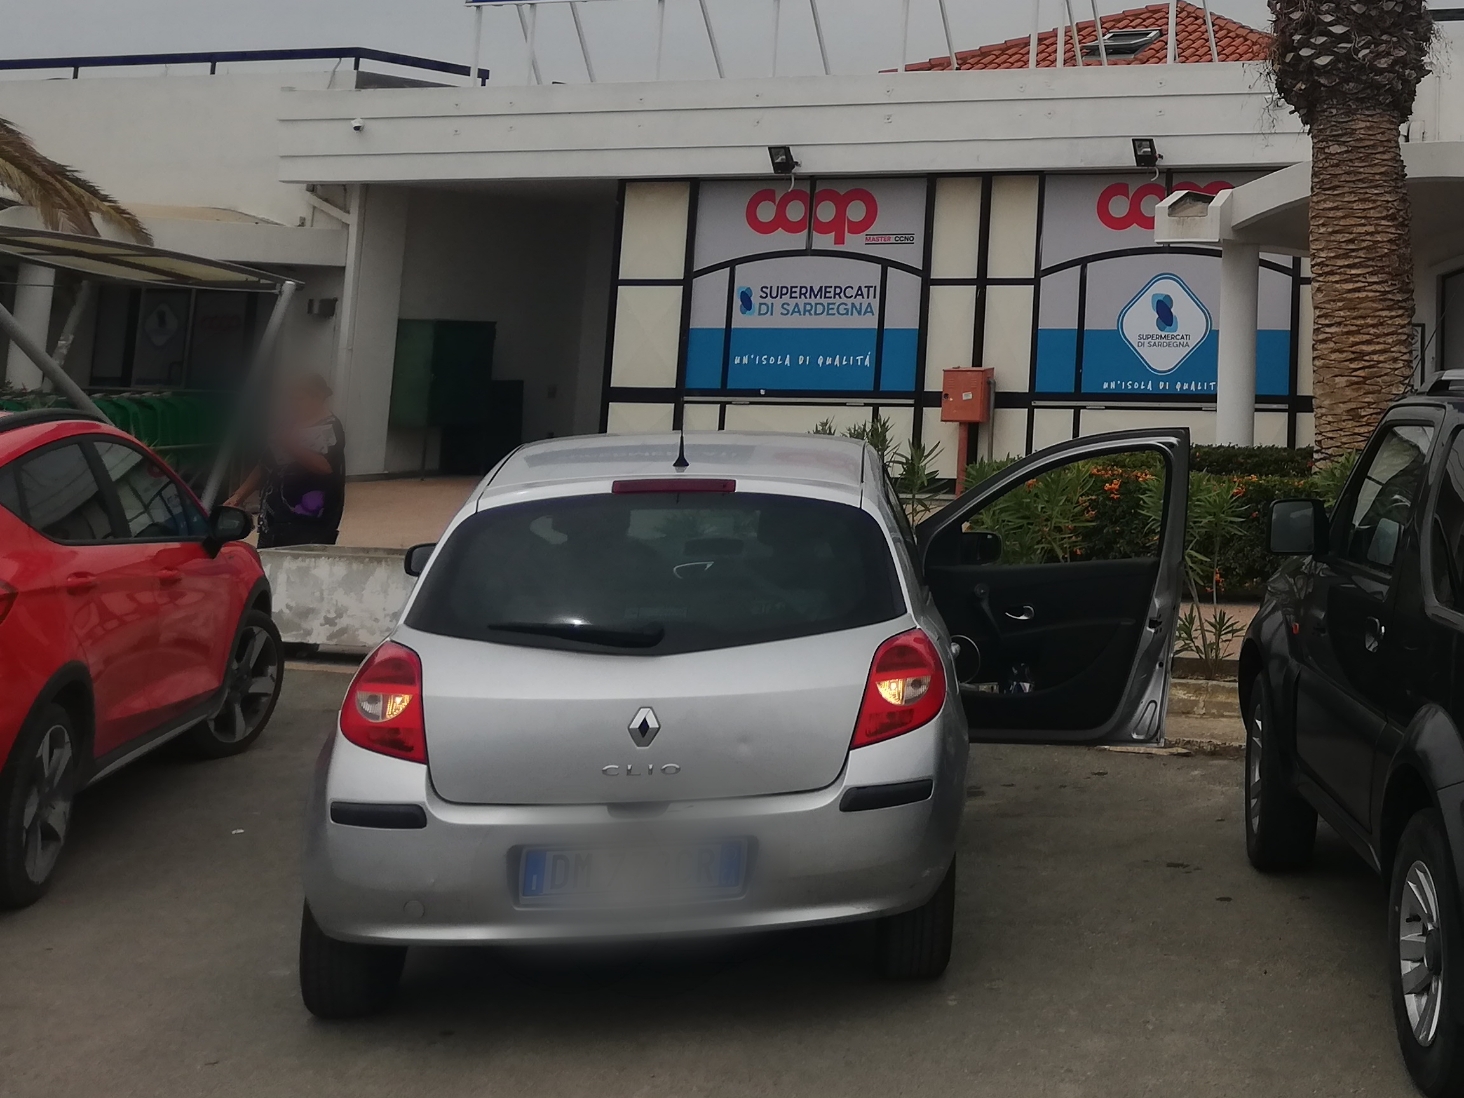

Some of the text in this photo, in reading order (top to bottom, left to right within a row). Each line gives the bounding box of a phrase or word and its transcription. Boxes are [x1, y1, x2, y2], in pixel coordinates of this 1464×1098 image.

[746, 188, 878, 245] coop
[865, 235, 915, 243] MASTER CCNO
[759, 285, 877, 300] SUPERMERCATI
[758, 302, 875, 317] DI SARDEGNA
[1137, 333, 1191, 341] SUPERMERCATI
[798, 354, 810, 366] DI
[1176, 381, 1218, 392] QUALIT
[602, 763, 681, 777] CLIO
